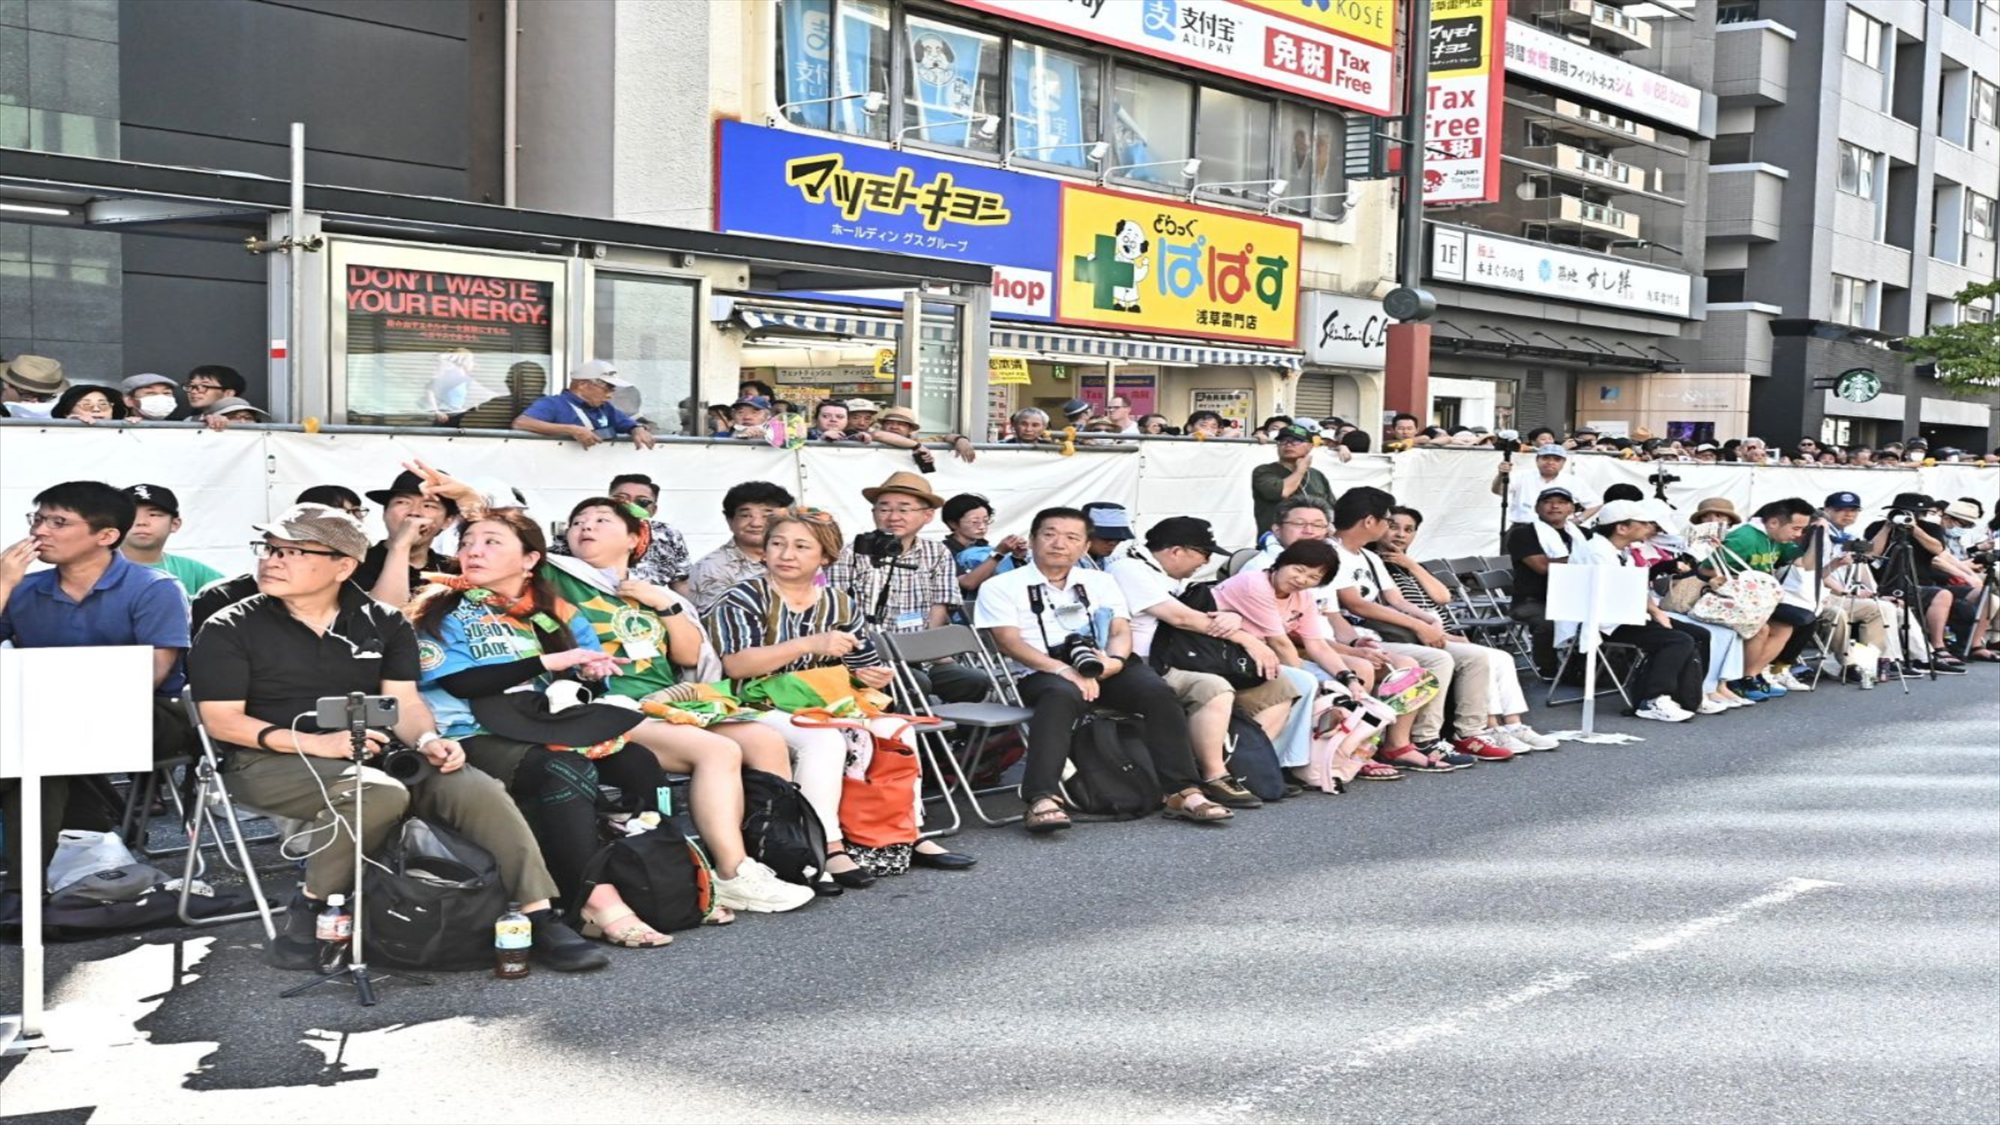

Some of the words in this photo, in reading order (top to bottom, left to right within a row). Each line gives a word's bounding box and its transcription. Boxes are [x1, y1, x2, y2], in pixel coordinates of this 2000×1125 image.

[1181, 6, 1236, 44] 支付宝
[1336, 0, 1383, 28] KOSÉ
[1182, 32, 1233, 55] ALIPAY
[1271, 31, 1328, 79] 免税
[1432, 41, 1472, 59] キヨシ
[1339, 47, 1371, 74] Tax
[1336, 68, 1372, 95] Free
[1426, 86, 1476, 111] Tax
[789, 156, 1009, 228] マツモトキヨシ
[1153, 213, 1199, 237] どらっく
[1440, 243, 1458, 264] 1F
[350, 267, 436, 292] DON'T
[444, 275, 537, 301] WASTE
[1157, 234, 1289, 311] ぱぱす
[993, 271, 1045, 306] hop
[346, 289, 427, 316] YOUR
[432, 297, 546, 325] ENERGY.
[1196, 309, 1257, 330] 浅草雷門店
